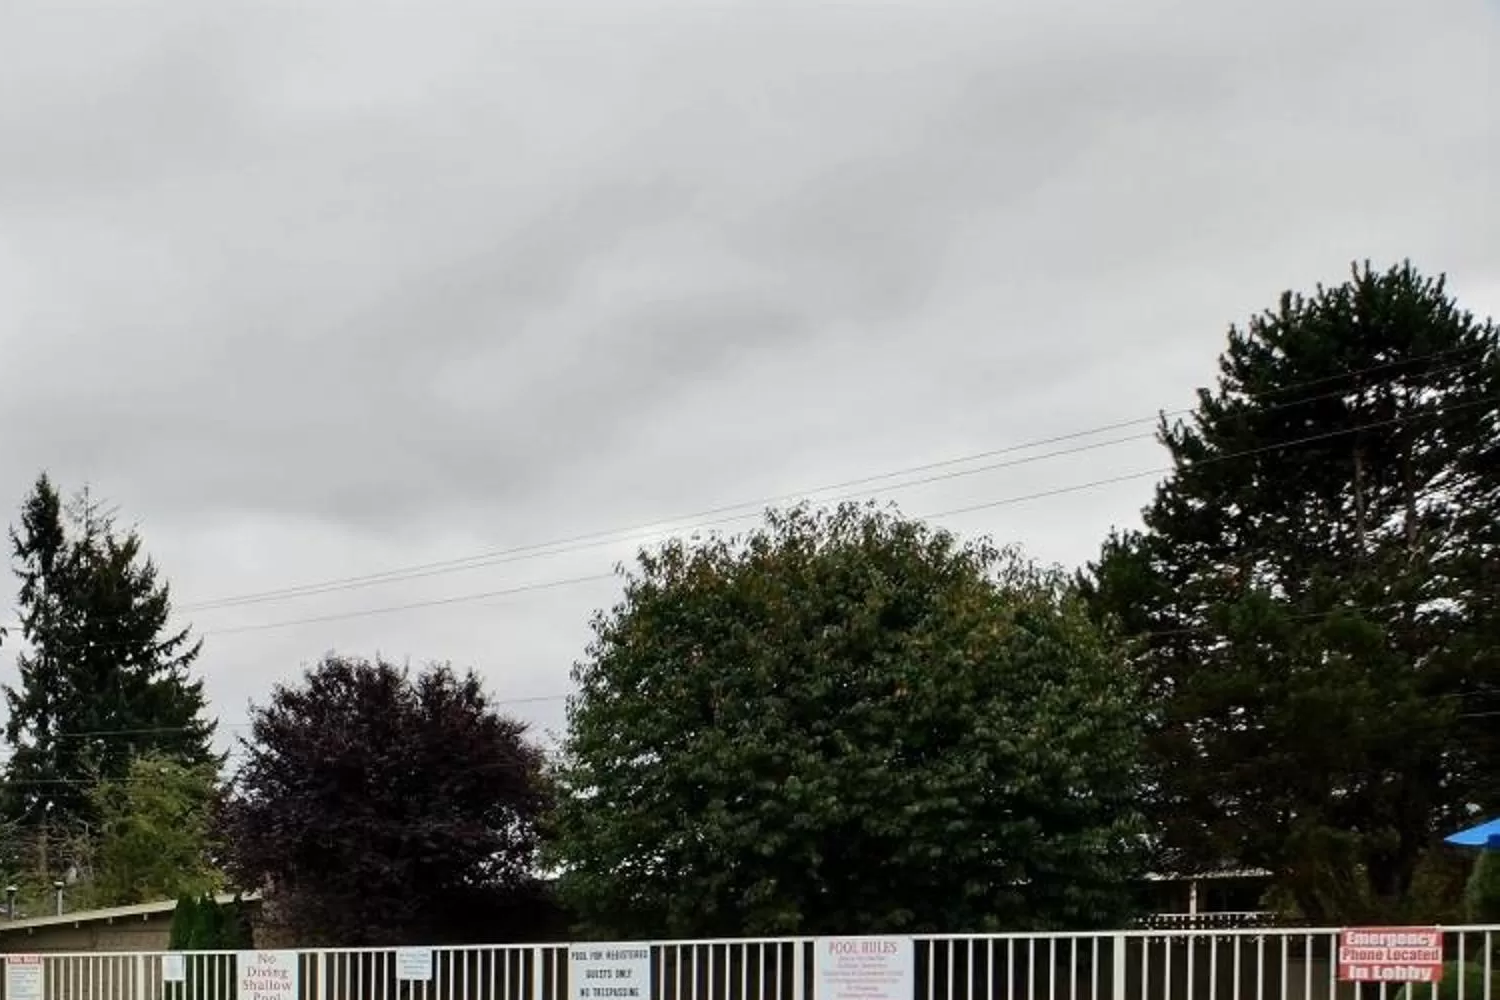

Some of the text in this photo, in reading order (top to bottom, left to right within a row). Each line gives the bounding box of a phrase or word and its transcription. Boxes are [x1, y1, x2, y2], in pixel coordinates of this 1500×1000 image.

[1347, 931, 1437, 947] Emergency
[828, 940, 897, 954] POOL RULES
[1342, 947, 1439, 960] Phone Located
[258, 952, 277, 964] No
[247, 966, 289, 980] Diving
[1349, 965, 1432, 981] In Lobby
[243, 979, 292, 990] Shallow
